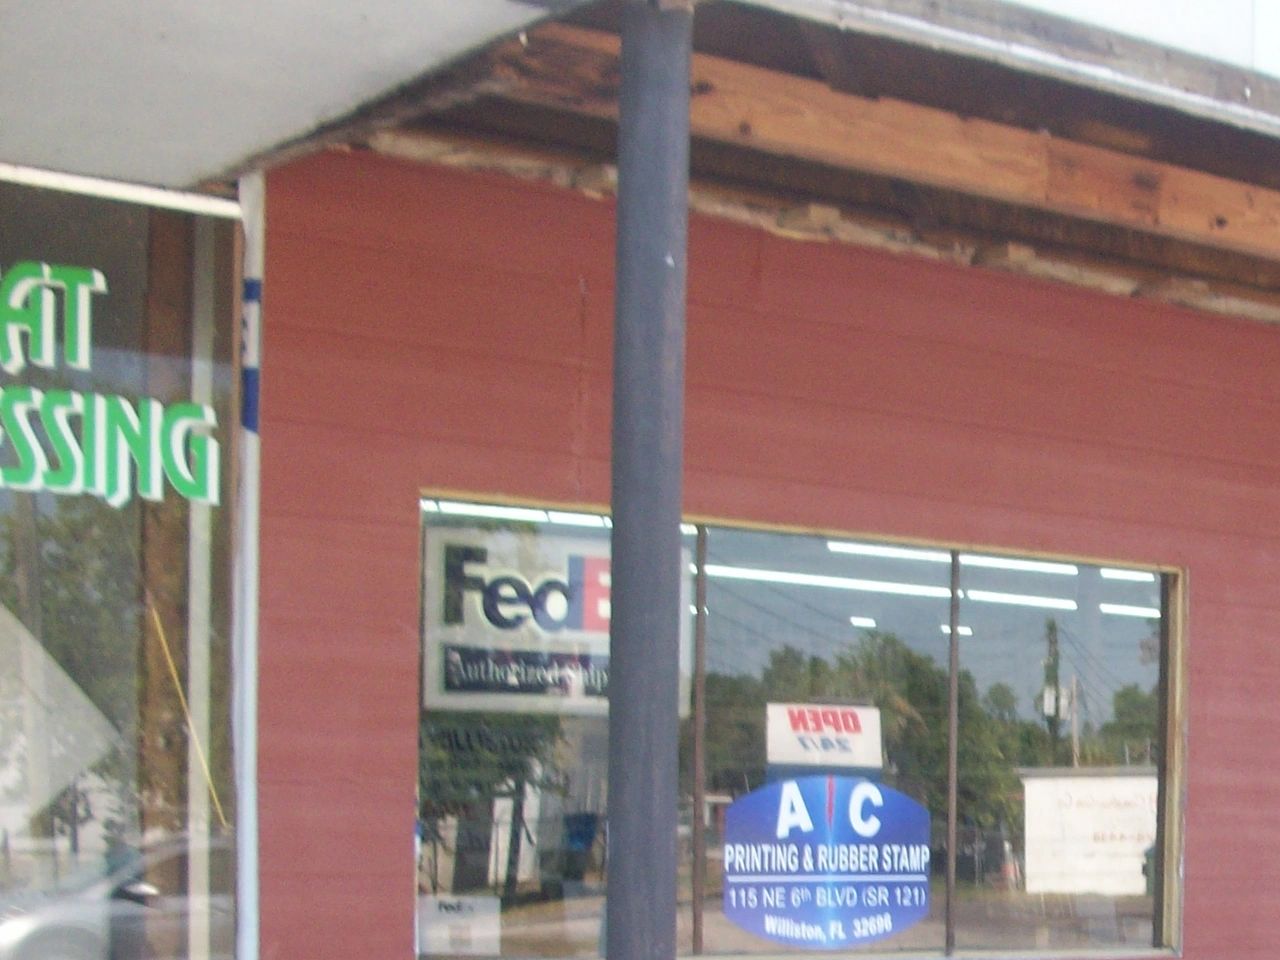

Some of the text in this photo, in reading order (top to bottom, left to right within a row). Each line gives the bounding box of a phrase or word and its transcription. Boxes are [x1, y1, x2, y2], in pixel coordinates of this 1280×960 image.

[444, 545, 611, 632] FedE
[776, 780, 883, 839] A C
[724, 844, 930, 873] PRINTING & RUBBER STAMP
[729, 887, 758, 909] 115
[763, 887, 786, 908] NE
[816, 887, 858, 908] BLVD
[830, 919, 847, 940] FL
